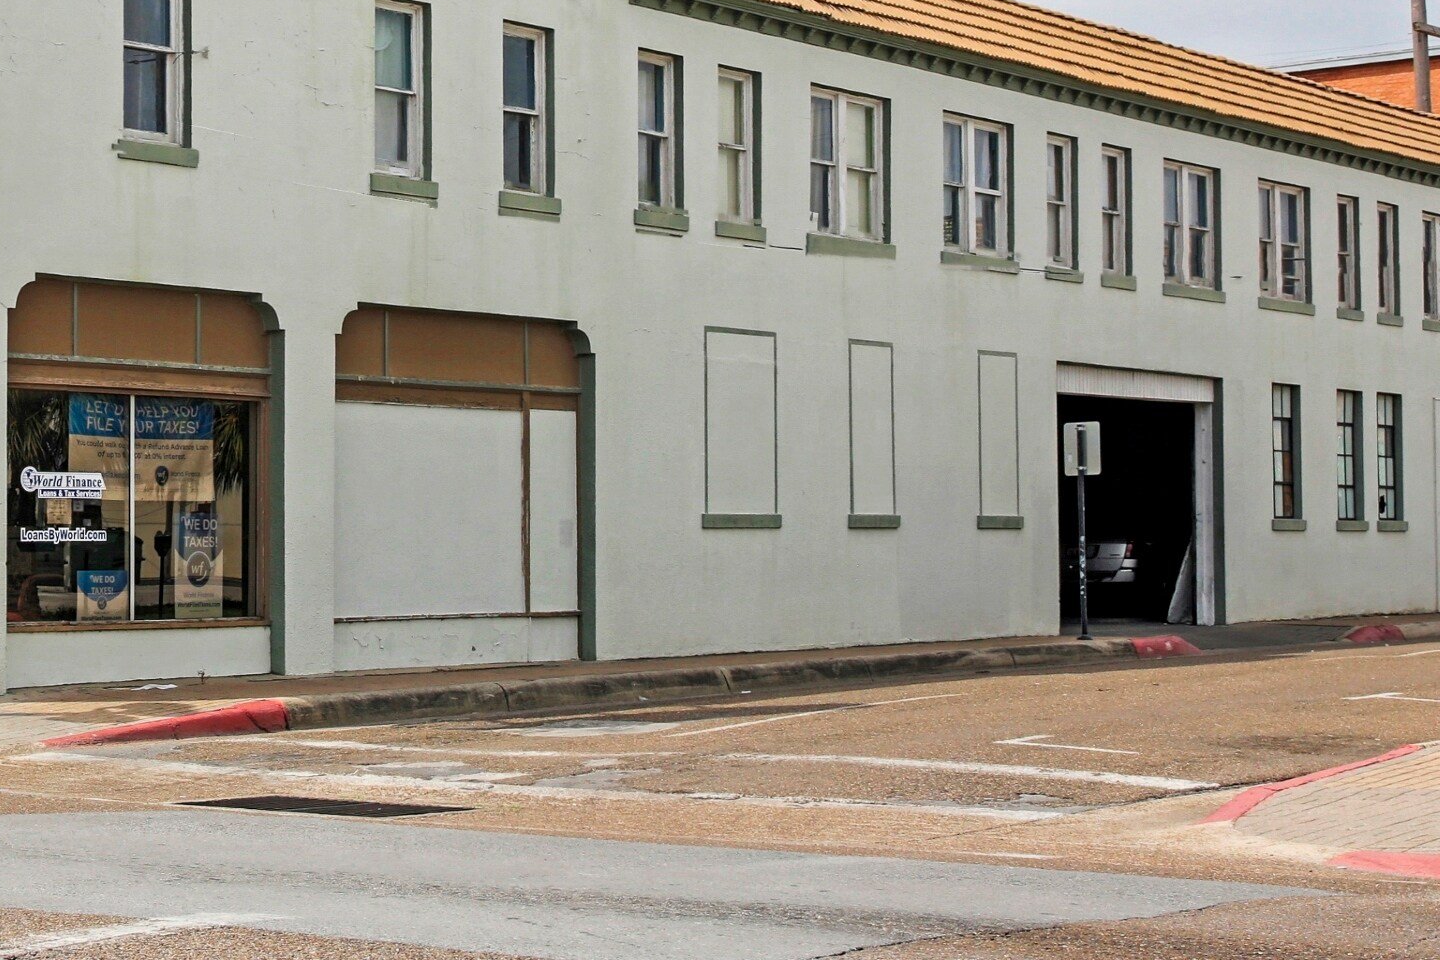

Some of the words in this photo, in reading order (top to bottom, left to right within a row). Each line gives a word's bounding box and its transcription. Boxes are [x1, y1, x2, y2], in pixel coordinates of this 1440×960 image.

[86, 400, 109, 416] LET
[137, 405, 169, 419] HELP
[171, 404, 200, 418] YOU
[86, 416, 114, 432] FILE
[119, 419, 154, 434] YUR
[158, 420, 200, 435] TAXES!
[33, 474, 63, 488] World
[66, 475, 102, 488] Finance
[203, 518, 218, 531] DO
[21, 528, 106, 543] LoansByWorld.com
[184, 536, 218, 548] TAXES!
[104, 575, 115, 583] DO
[90, 586, 114, 595] TAXES!
